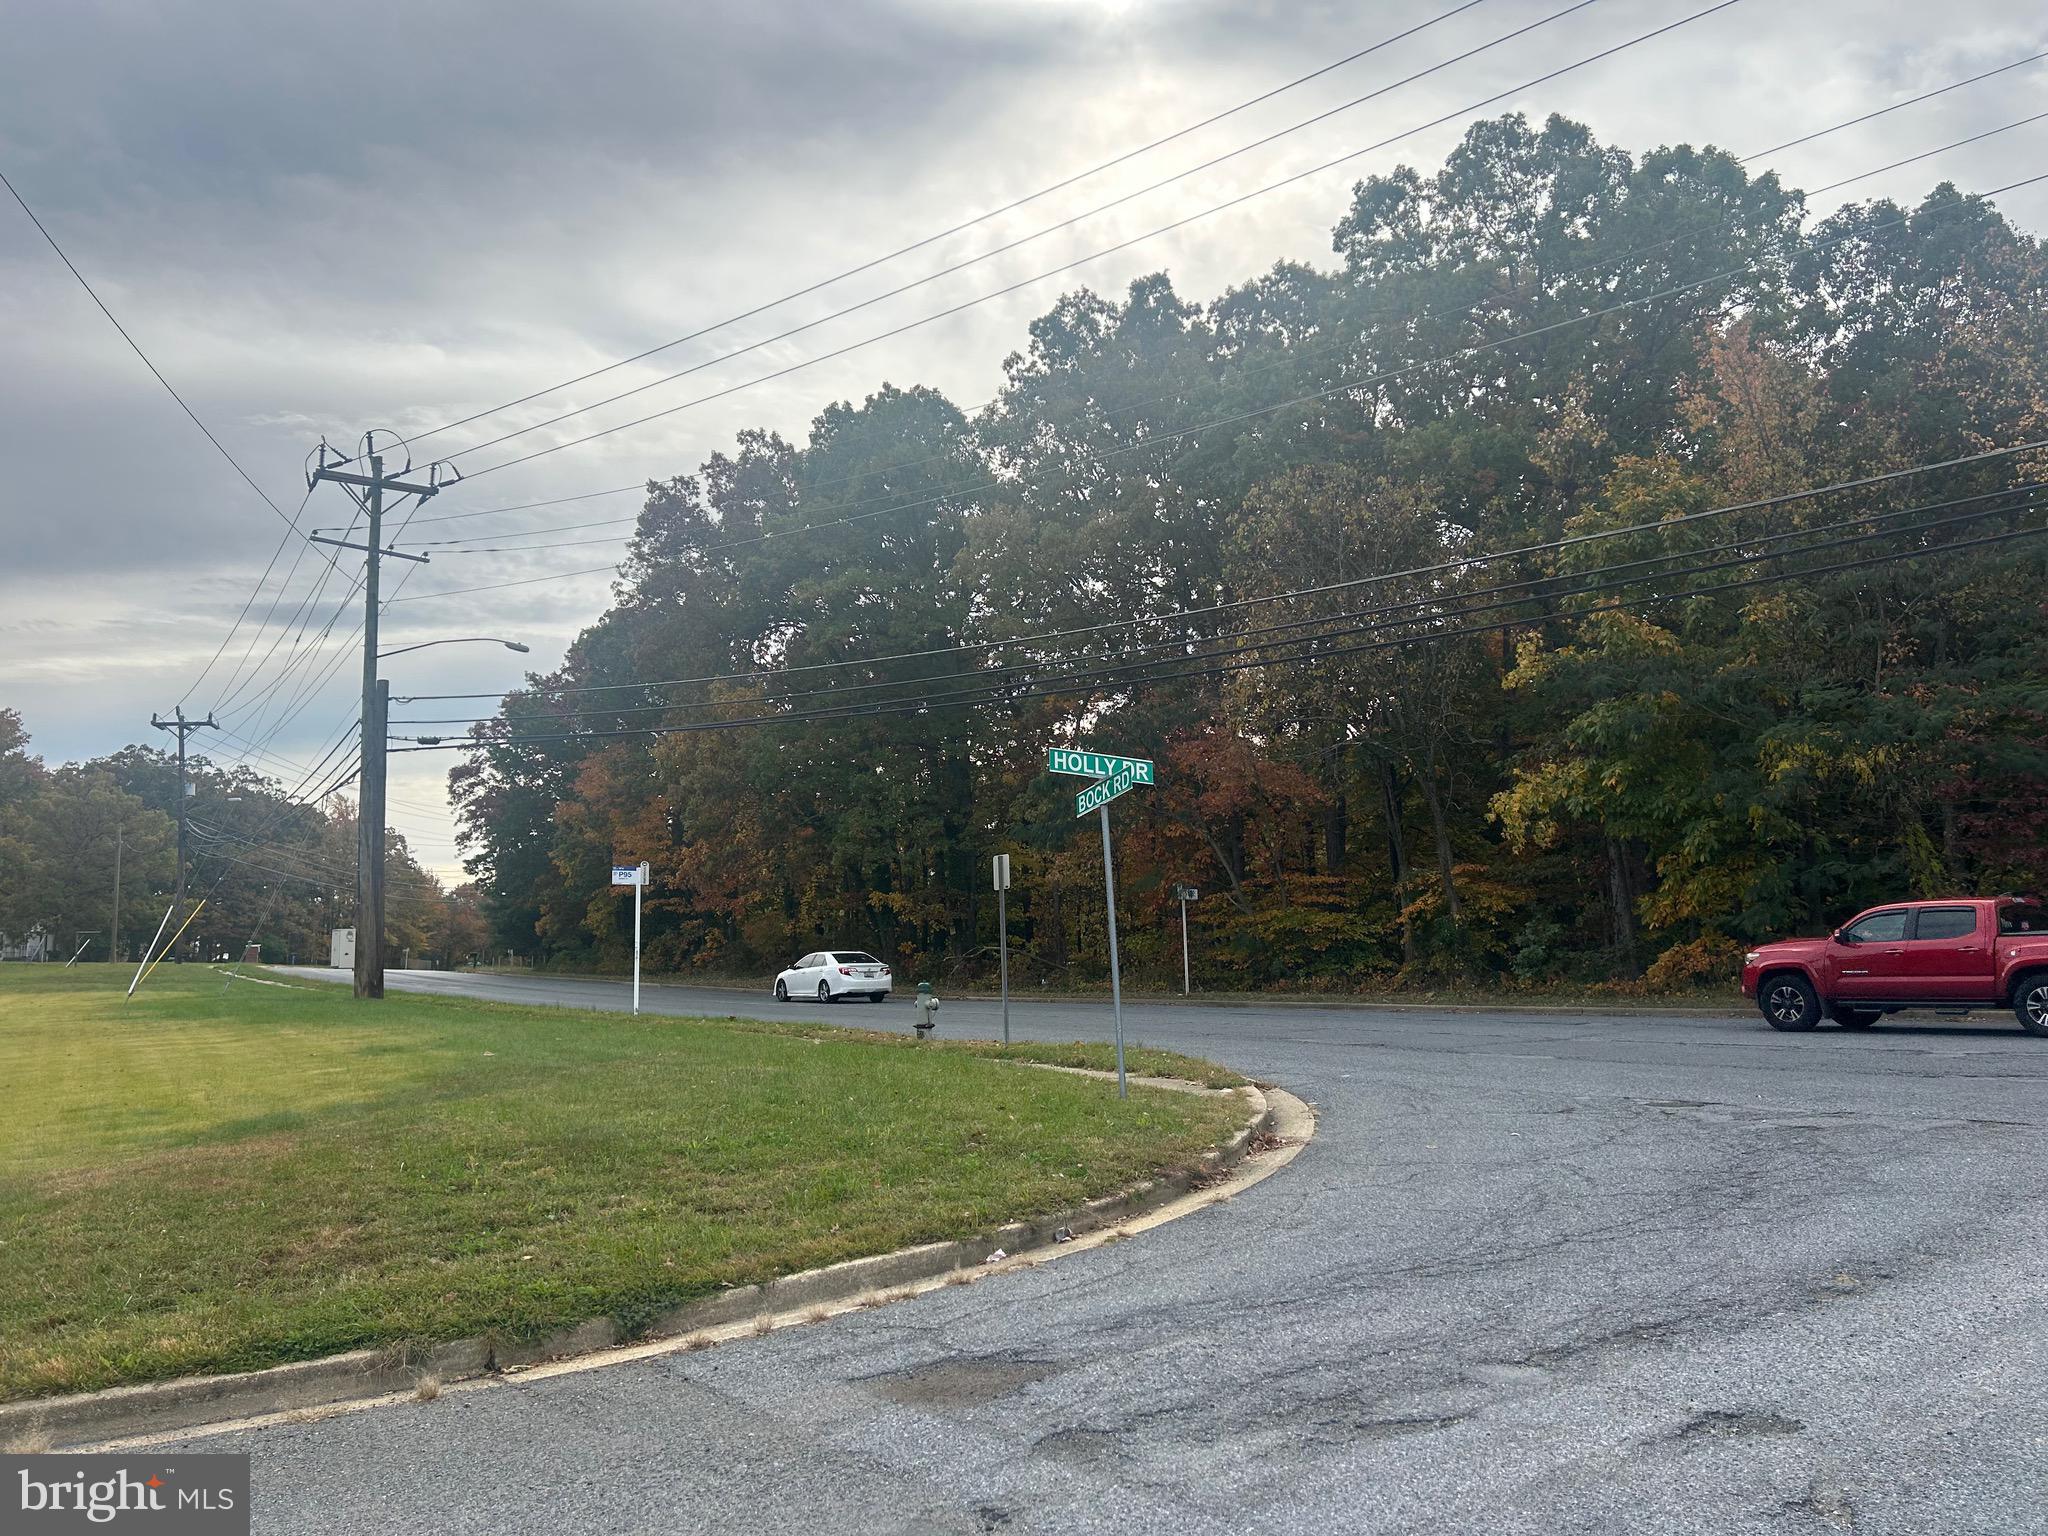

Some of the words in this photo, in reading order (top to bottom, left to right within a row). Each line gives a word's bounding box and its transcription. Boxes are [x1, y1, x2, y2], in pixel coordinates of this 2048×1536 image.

[1054, 751, 1116, 776] HOLLY
[1078, 781, 1111, 813] BOCK
[1113, 770, 1130, 794] RD
